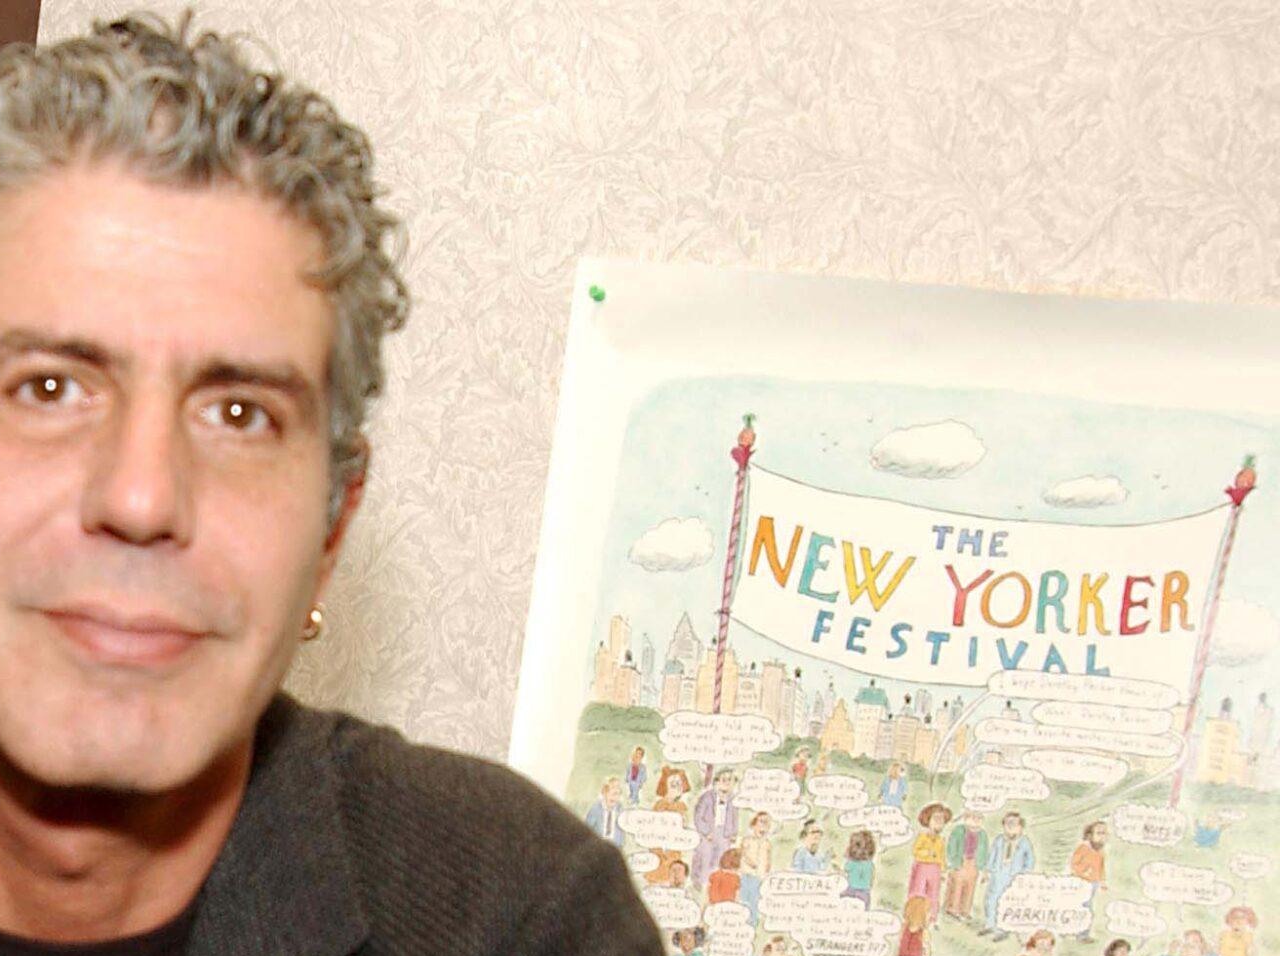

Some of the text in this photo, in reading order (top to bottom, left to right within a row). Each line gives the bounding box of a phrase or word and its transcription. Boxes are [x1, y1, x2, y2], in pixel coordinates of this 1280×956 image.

[932, 525, 1008, 558] THE
[748, 515, 1195, 637] NEW YORKER
[811, 610, 1110, 678] FESTIVAL
